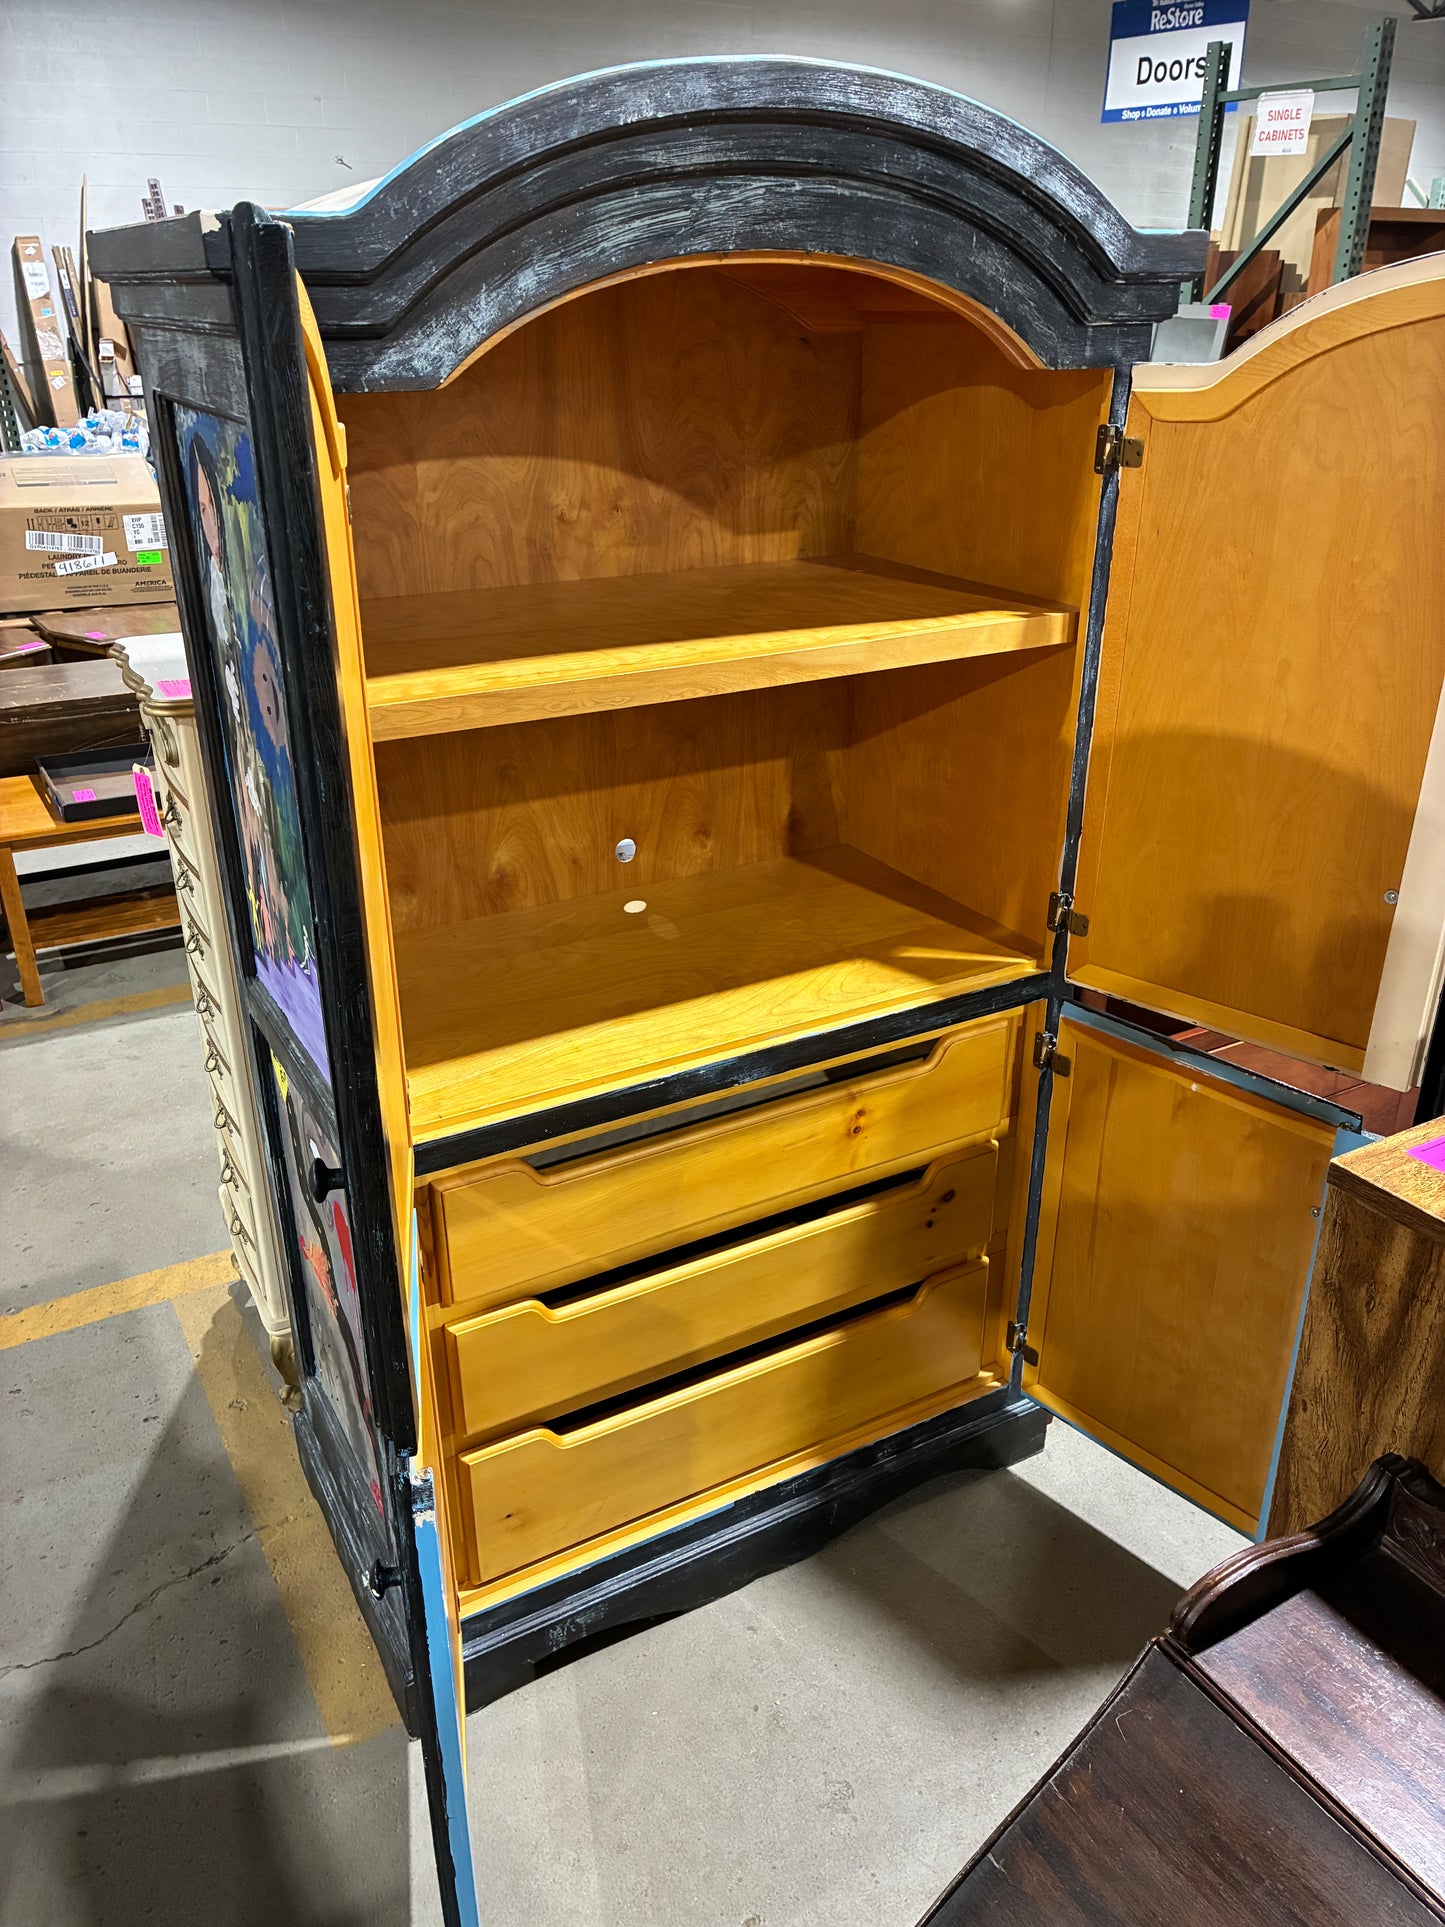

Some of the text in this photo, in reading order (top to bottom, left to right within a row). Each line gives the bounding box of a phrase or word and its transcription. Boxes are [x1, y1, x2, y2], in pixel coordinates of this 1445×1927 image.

[1150, 7, 1204, 31] ReStore
[1136, 56, 1206, 85] Doors
[1121, 103, 1201, 120] Shop Donate Volun
[1267, 108, 1302, 121] SINGLE
[1258, 128, 1305, 142] CABINETS
[47, 553, 83, 561] LAUNDRY
[58, 555, 105, 574] 418611
[112, 567, 152, 575] BUANDERIE
